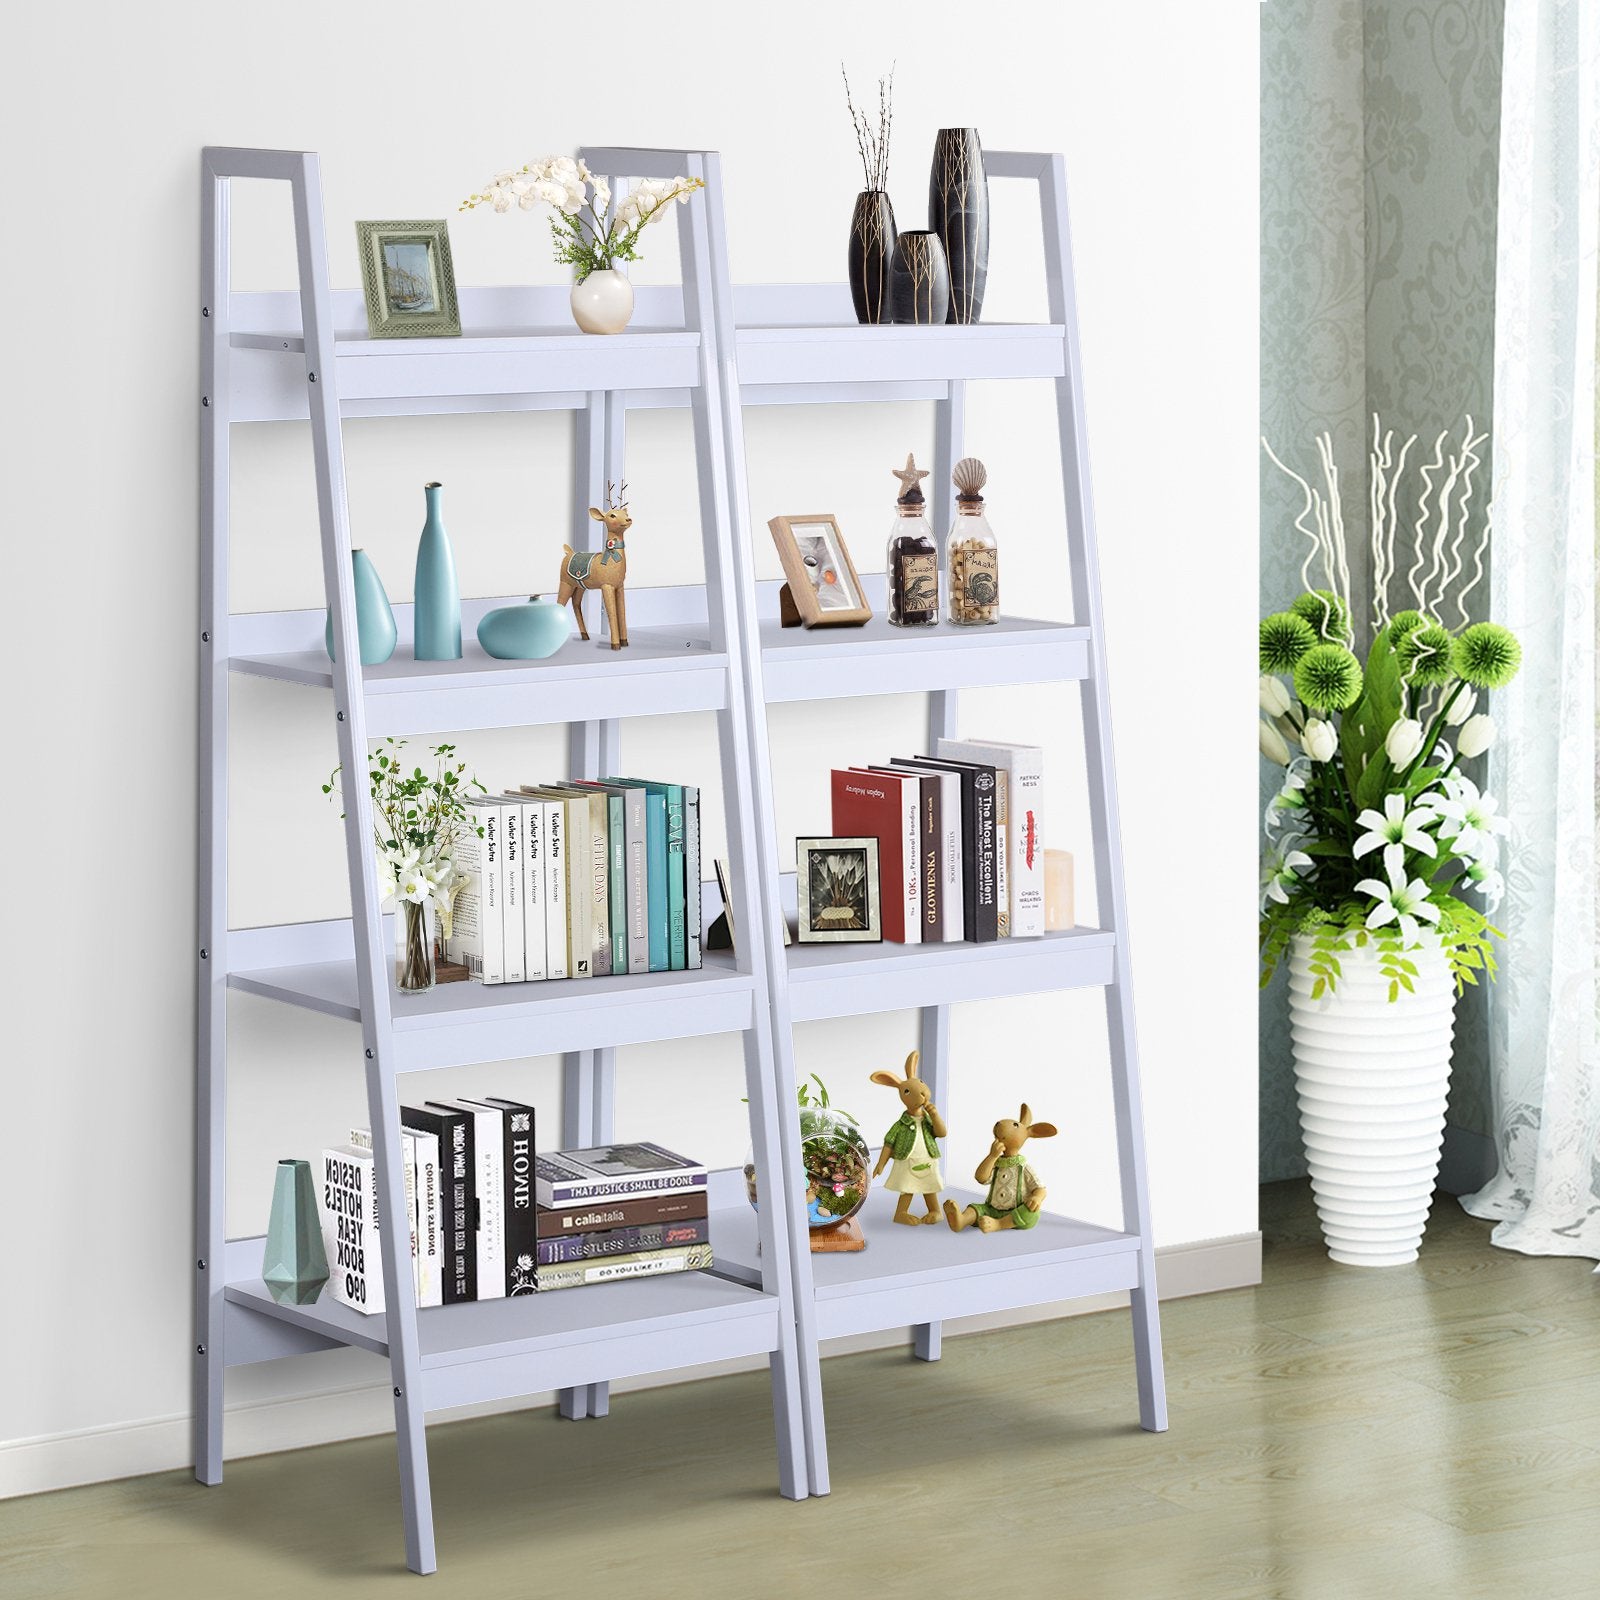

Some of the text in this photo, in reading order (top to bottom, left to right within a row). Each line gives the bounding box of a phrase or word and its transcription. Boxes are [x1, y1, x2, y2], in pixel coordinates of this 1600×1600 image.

[983, 796, 992, 818] The
[668, 803, 683, 854] LOVE
[983, 820, 992, 848] Most
[594, 874, 605, 903] DAYS
[908, 877, 916, 901] 10Ks
[984, 852, 993, 905] Excellent
[674, 910, 683, 956] MERRITT
[570, 1175, 693, 1198] THAT JUSTICE SHALL BE DONE
[569, 1239, 625, 1258] RESTLESS
[599, 1269, 612, 1277] DO
[615, 1266, 632, 1274] YOU
[633, 1264, 652, 1272] LIKE
